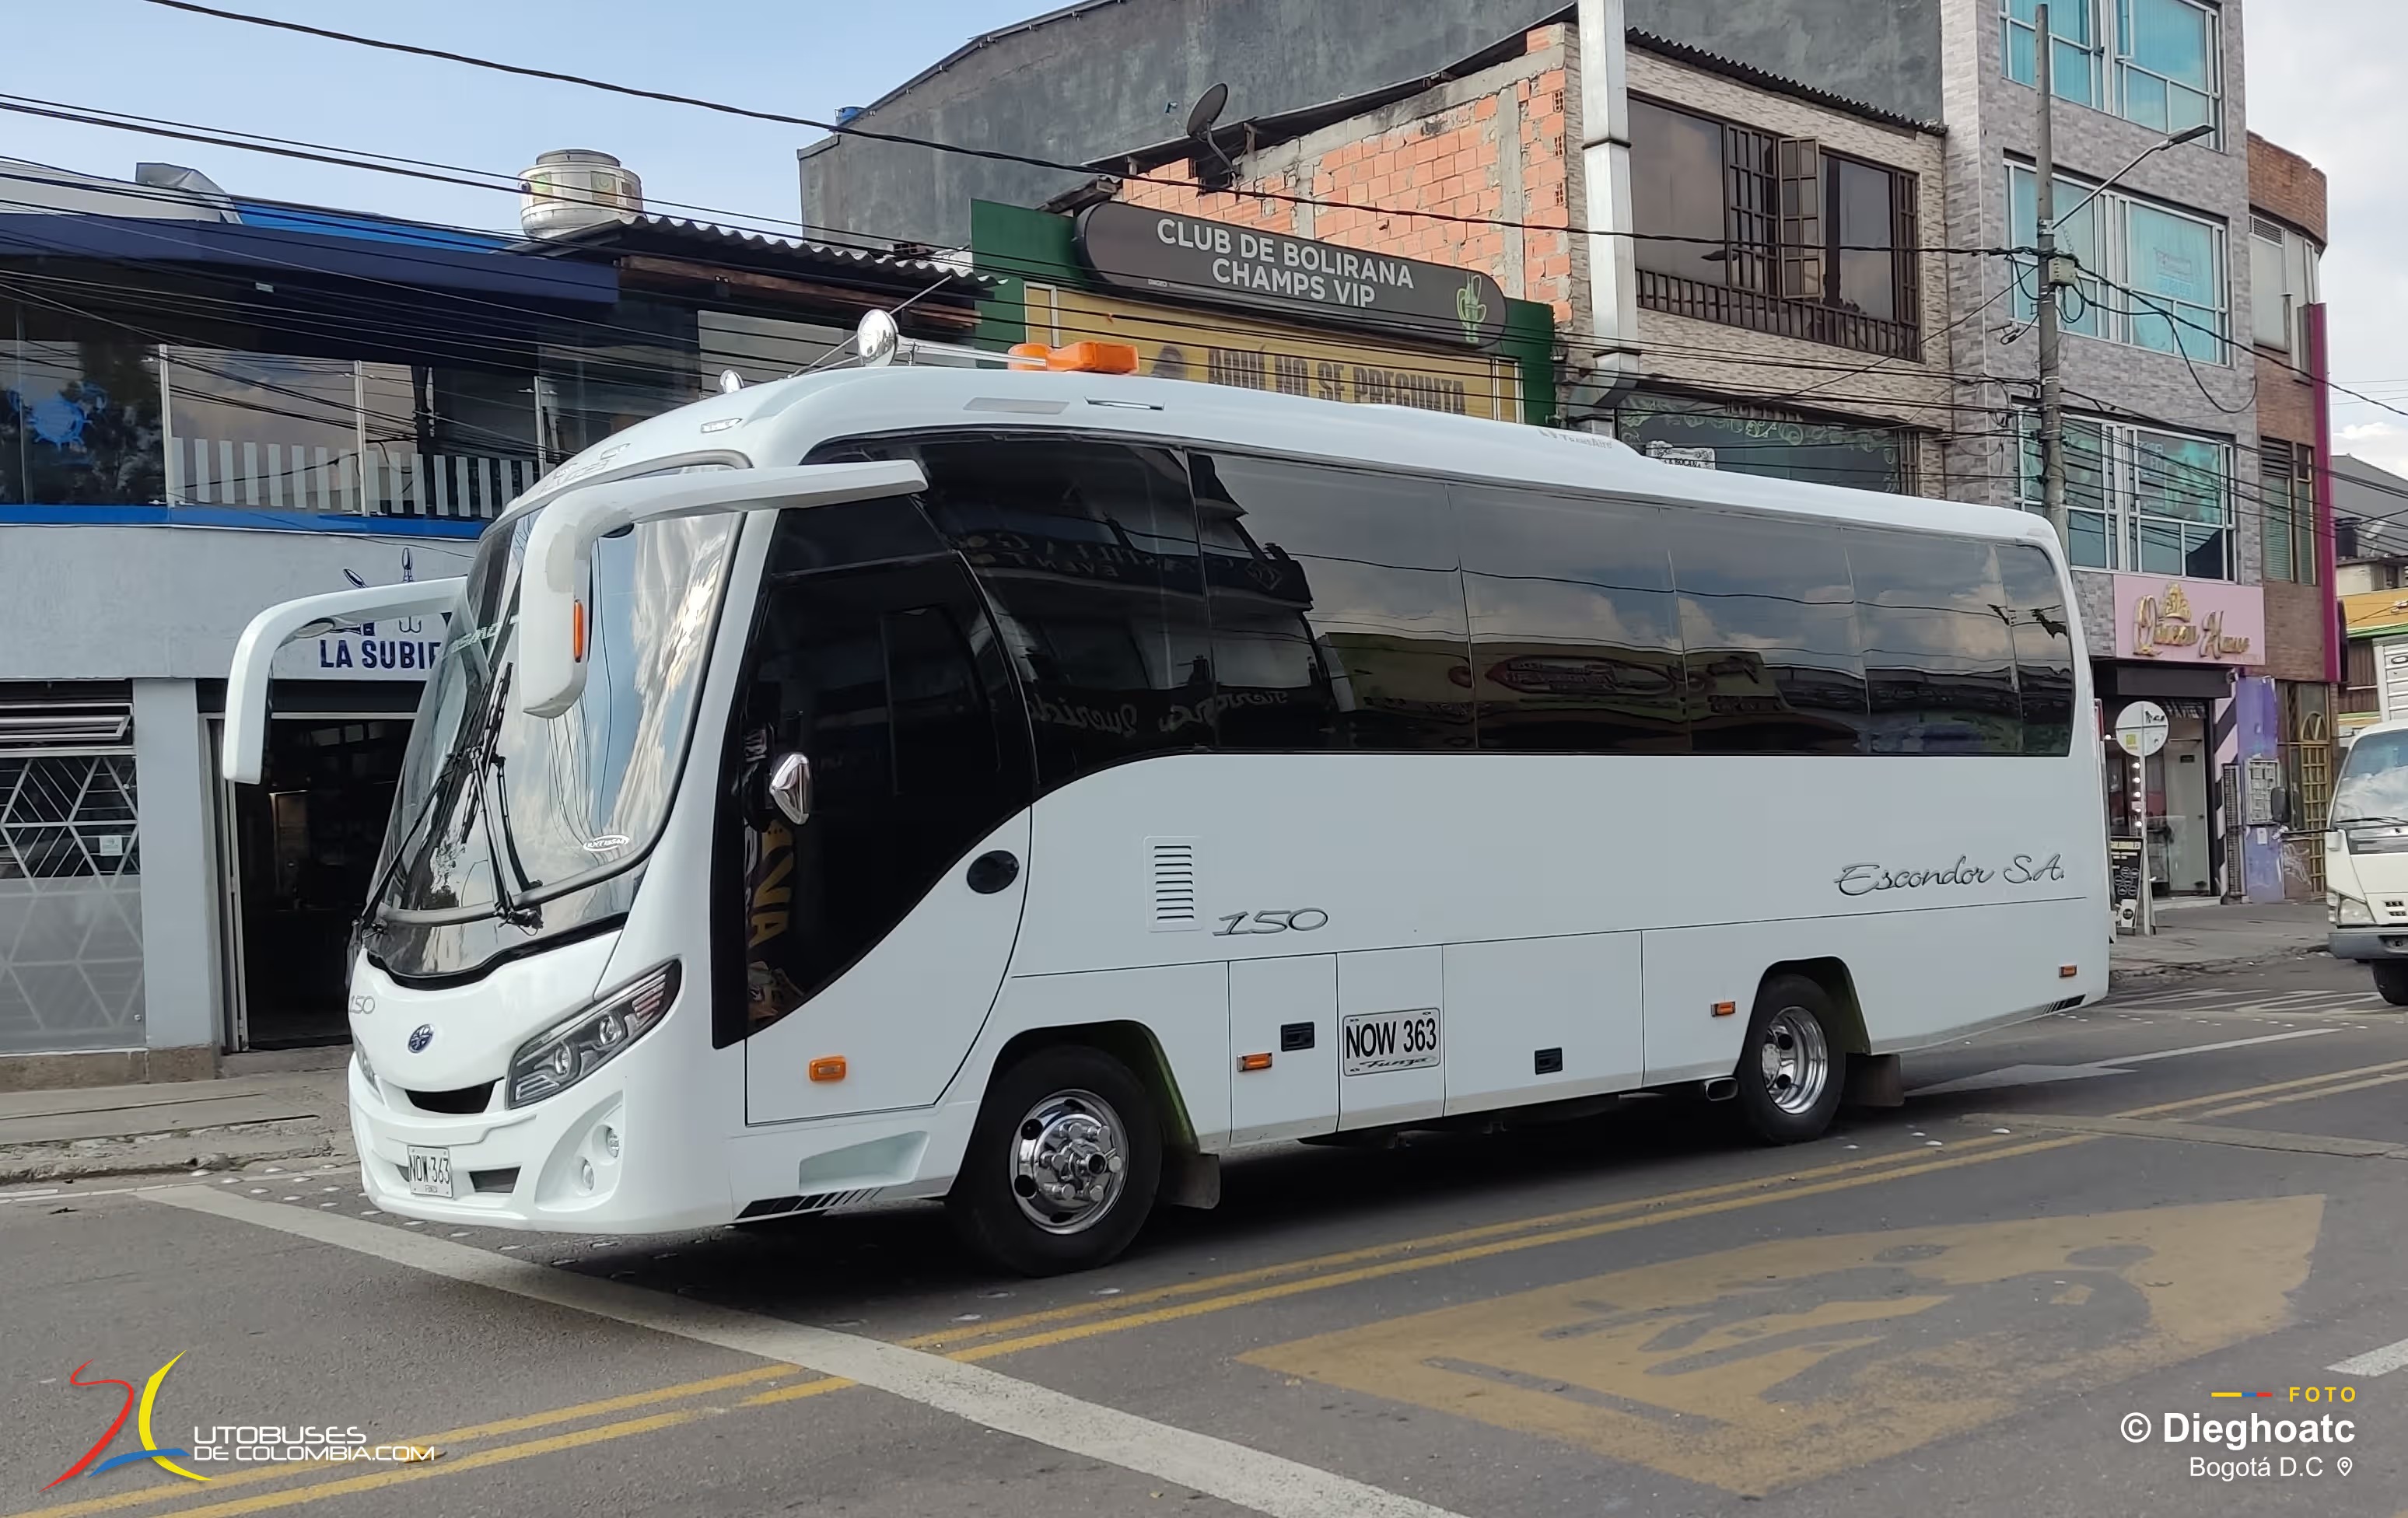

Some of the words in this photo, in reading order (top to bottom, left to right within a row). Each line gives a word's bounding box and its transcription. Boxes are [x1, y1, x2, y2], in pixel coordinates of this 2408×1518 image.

[1157, 219, 1231, 254] CLUB
[1240, 233, 1276, 263] DE
[1283, 242, 1415, 289] BOLIRANA
[1212, 257, 1326, 300] CHAMPS
[1333, 278, 1376, 308] VIP
[1274, 352, 1310, 397] NO
[1318, 362, 1345, 402] SE
[1353, 366, 1467, 415] PREGUNTA
[320, 639, 353, 668] LA
[1832, 854, 1996, 896] Escondor
[2004, 853, 2065, 884] S.A.
[1212, 907, 1328, 936] 150
[1346, 1021, 1397, 1059] NOW
[1403, 1018, 1437, 1052] 363
